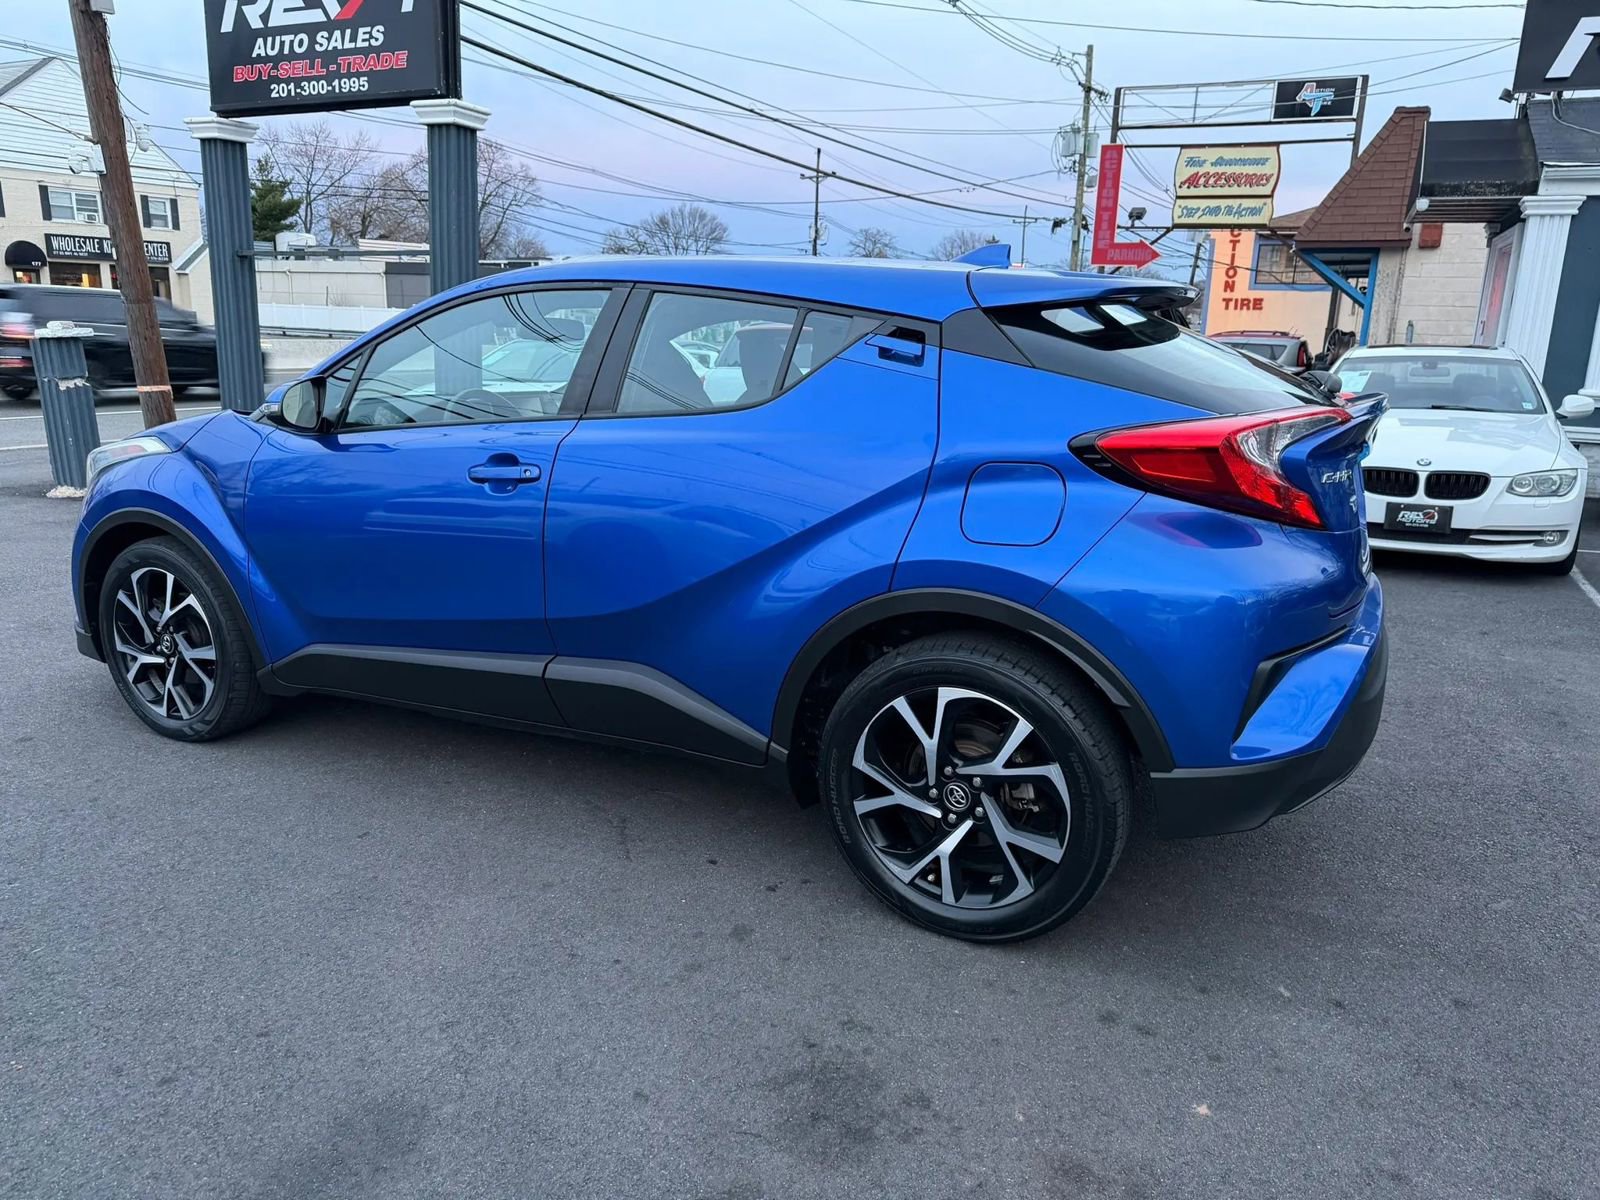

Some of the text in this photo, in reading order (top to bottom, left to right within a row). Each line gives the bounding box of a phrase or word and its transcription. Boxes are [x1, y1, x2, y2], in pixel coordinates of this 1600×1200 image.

[251, 25, 385, 58] AUTO SALES
[270, 77, 369, 98] 201-300-1995
[1179, 171, 1273, 189] ACCESSORIES
[50, 236, 101, 253] WHOLESALE
[144, 243, 169, 257] ENTER
[1107, 249, 1152, 262] PARKING
[1224, 229, 1242, 292] CTION
[1222, 298, 1264, 311] TIRE
